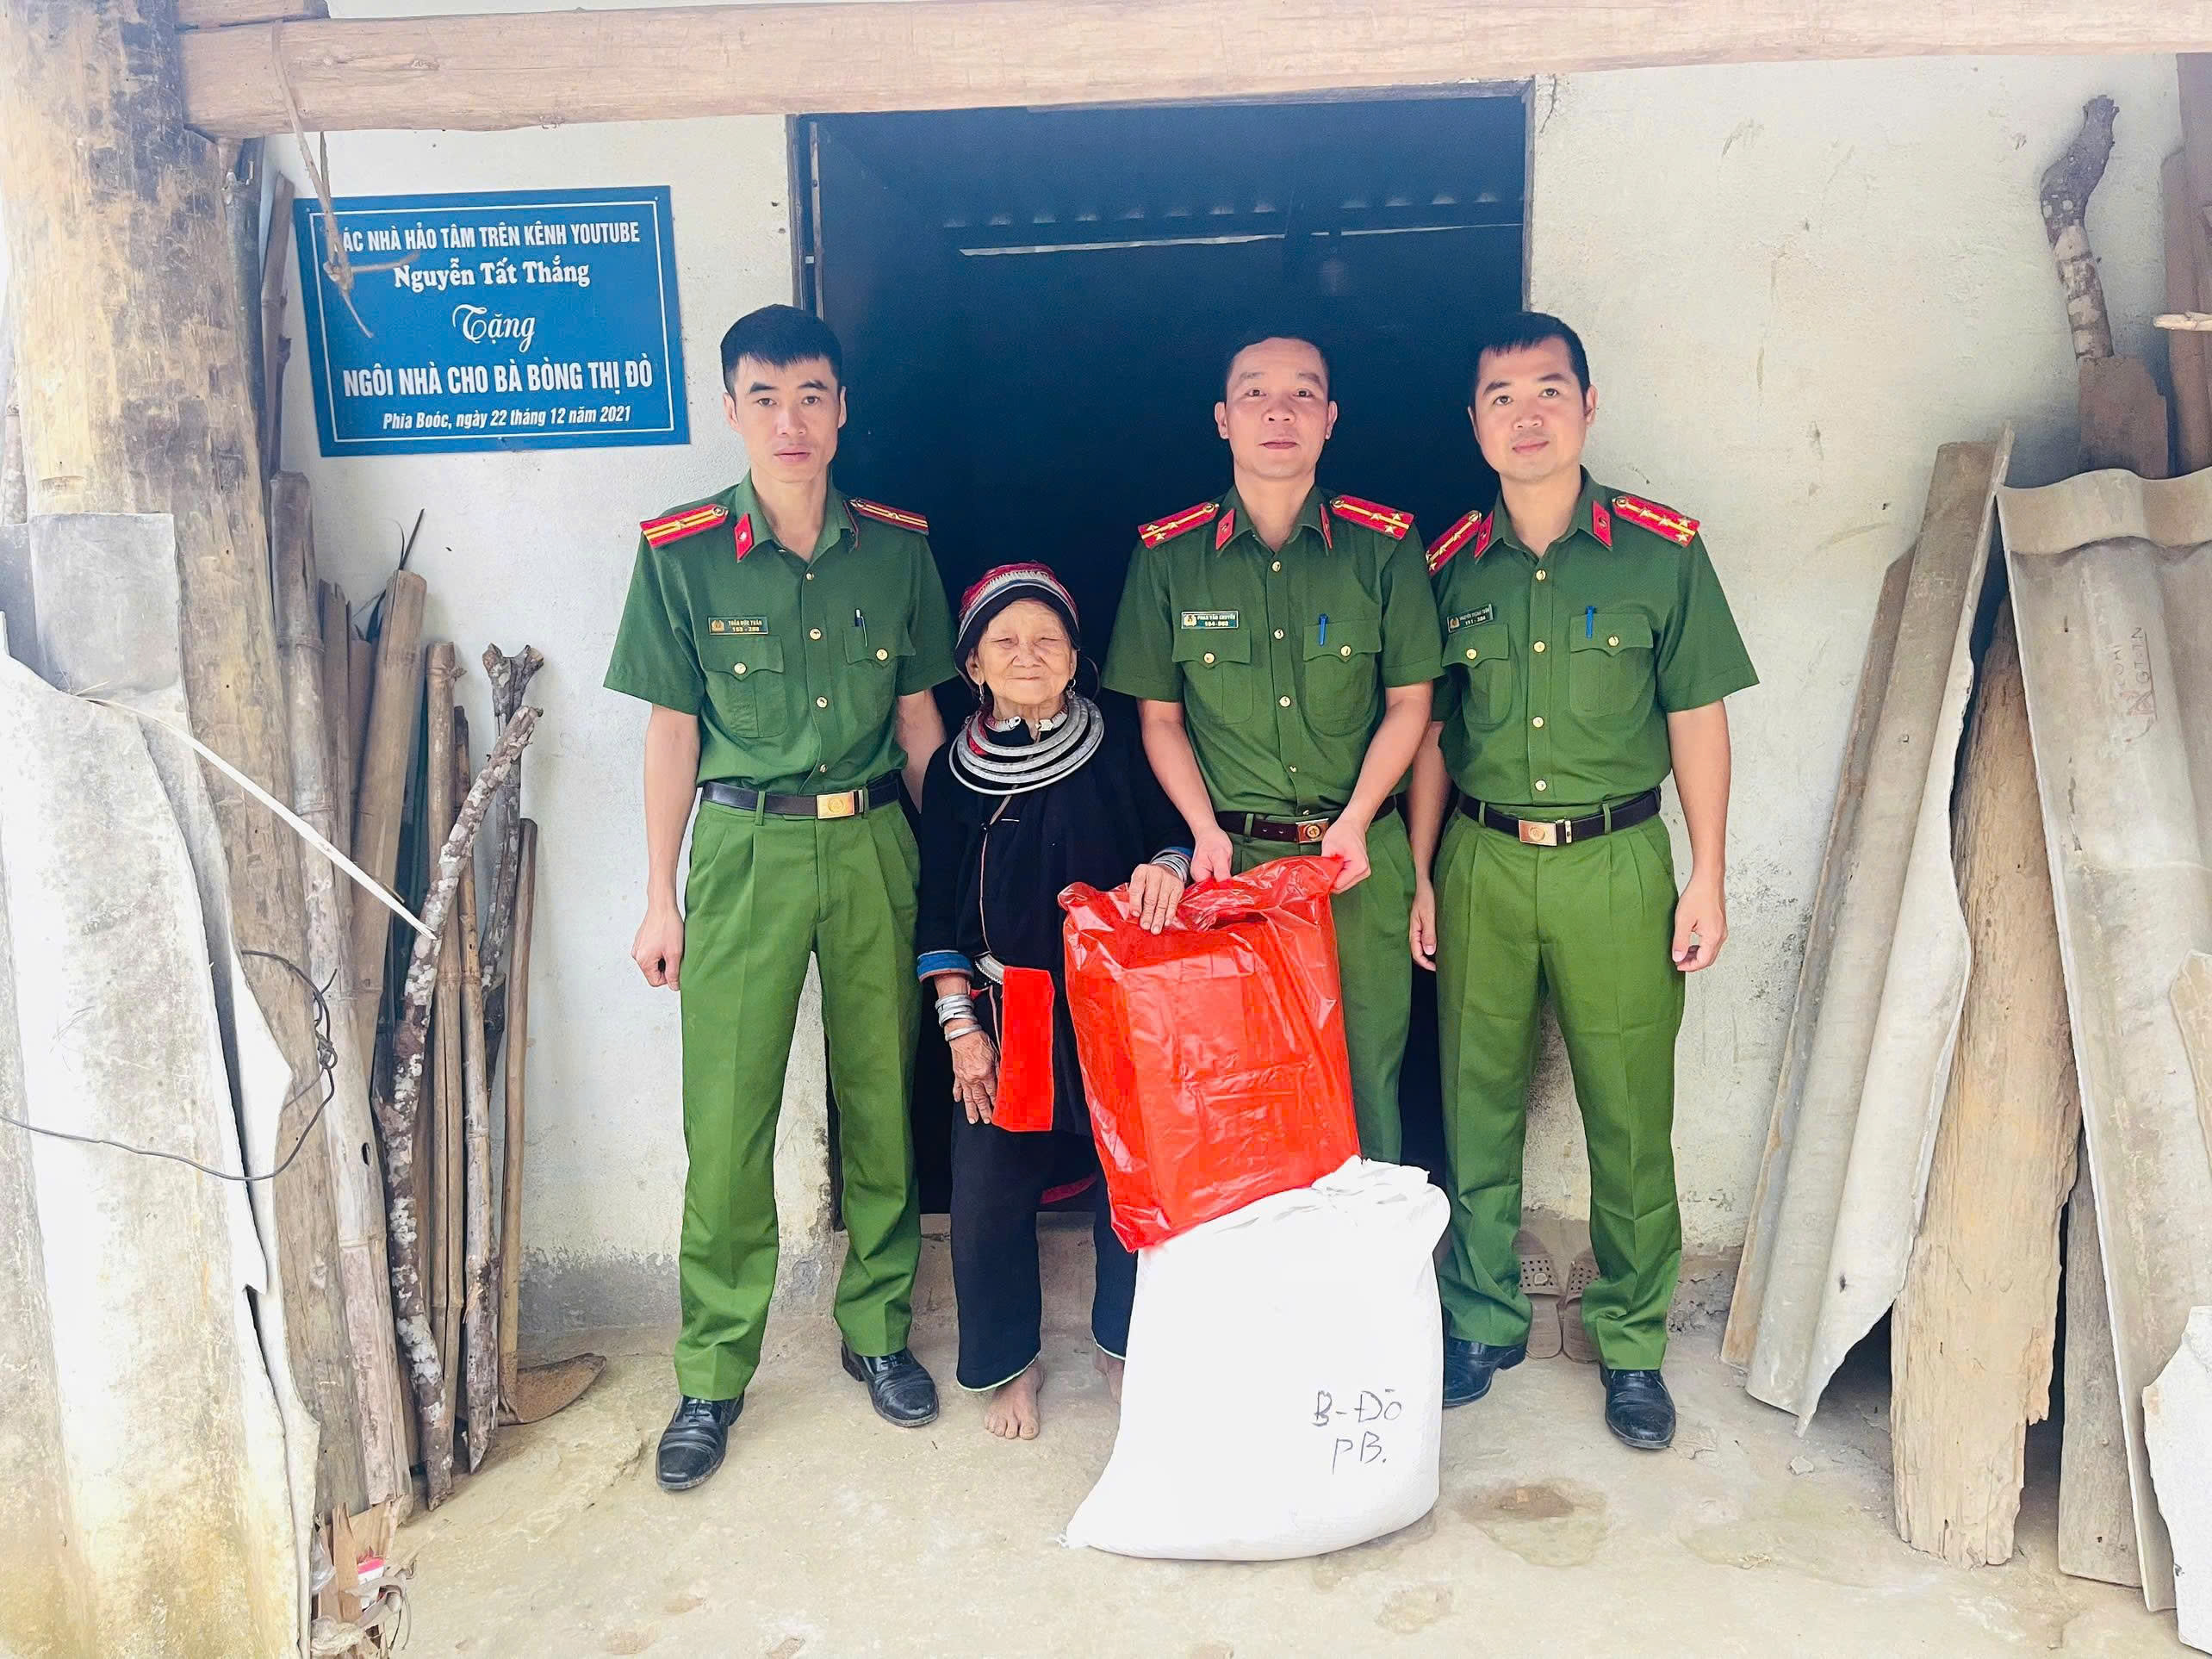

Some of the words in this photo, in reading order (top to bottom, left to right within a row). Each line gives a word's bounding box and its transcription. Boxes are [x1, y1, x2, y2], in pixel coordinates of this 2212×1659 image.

[337, 227, 363, 252] ÁC
[367, 225, 402, 252] NHÀ
[404, 221, 437, 250] HẢO
[440, 223, 475, 249] TÂM
[479, 221, 520, 247] TRÊN
[524, 220, 568, 246] KÊNH
[570, 221, 641, 245] YOUTUBE
[393, 258, 475, 294] Nguyễn
[480, 257, 518, 285] Tất
[522, 254, 591, 288] Thắng
[452, 303, 536, 353] Tặng
[343, 363, 394, 397] NGÔI
[399, 361, 444, 395] NHÀ
[447, 365, 488, 394] CHO
[494, 358, 523, 393] BÀ
[526, 356, 584, 391] BÒNG
[587, 360, 621, 395] THỊ
[624, 352, 653, 388] ĐÒ
[415, 410, 452, 430] Boóc,
[456, 409, 488, 429] ngày
[489, 409, 507, 427] 22
[510, 407, 547, 427] tháng
[550, 407, 567, 425] 12
[569, 406, 598, 425] năm
[599, 405, 631, 423] 2021
